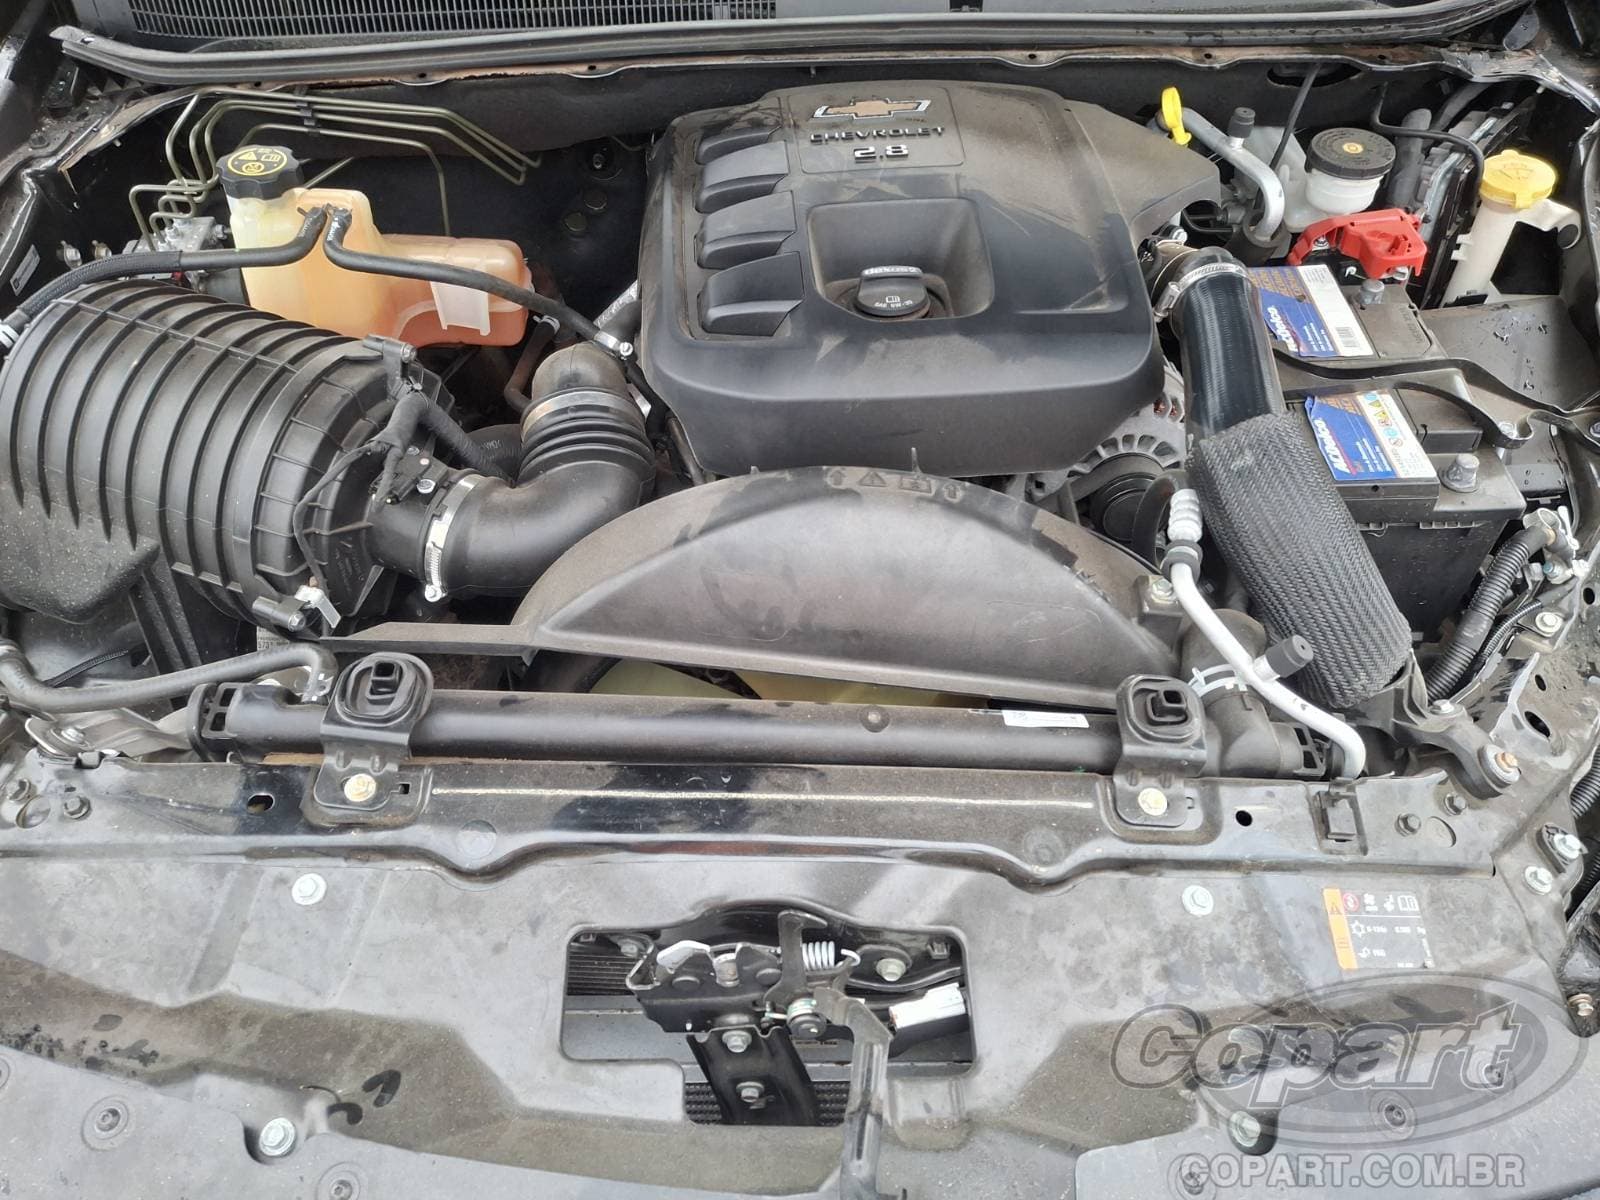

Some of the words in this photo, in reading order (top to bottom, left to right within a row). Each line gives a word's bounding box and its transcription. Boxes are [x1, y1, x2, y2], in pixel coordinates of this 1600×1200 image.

[810, 126, 945, 144] CHEVROLET
[853, 144, 909, 163] 2.8
[1313, 416, 1352, 475] ACDelco
